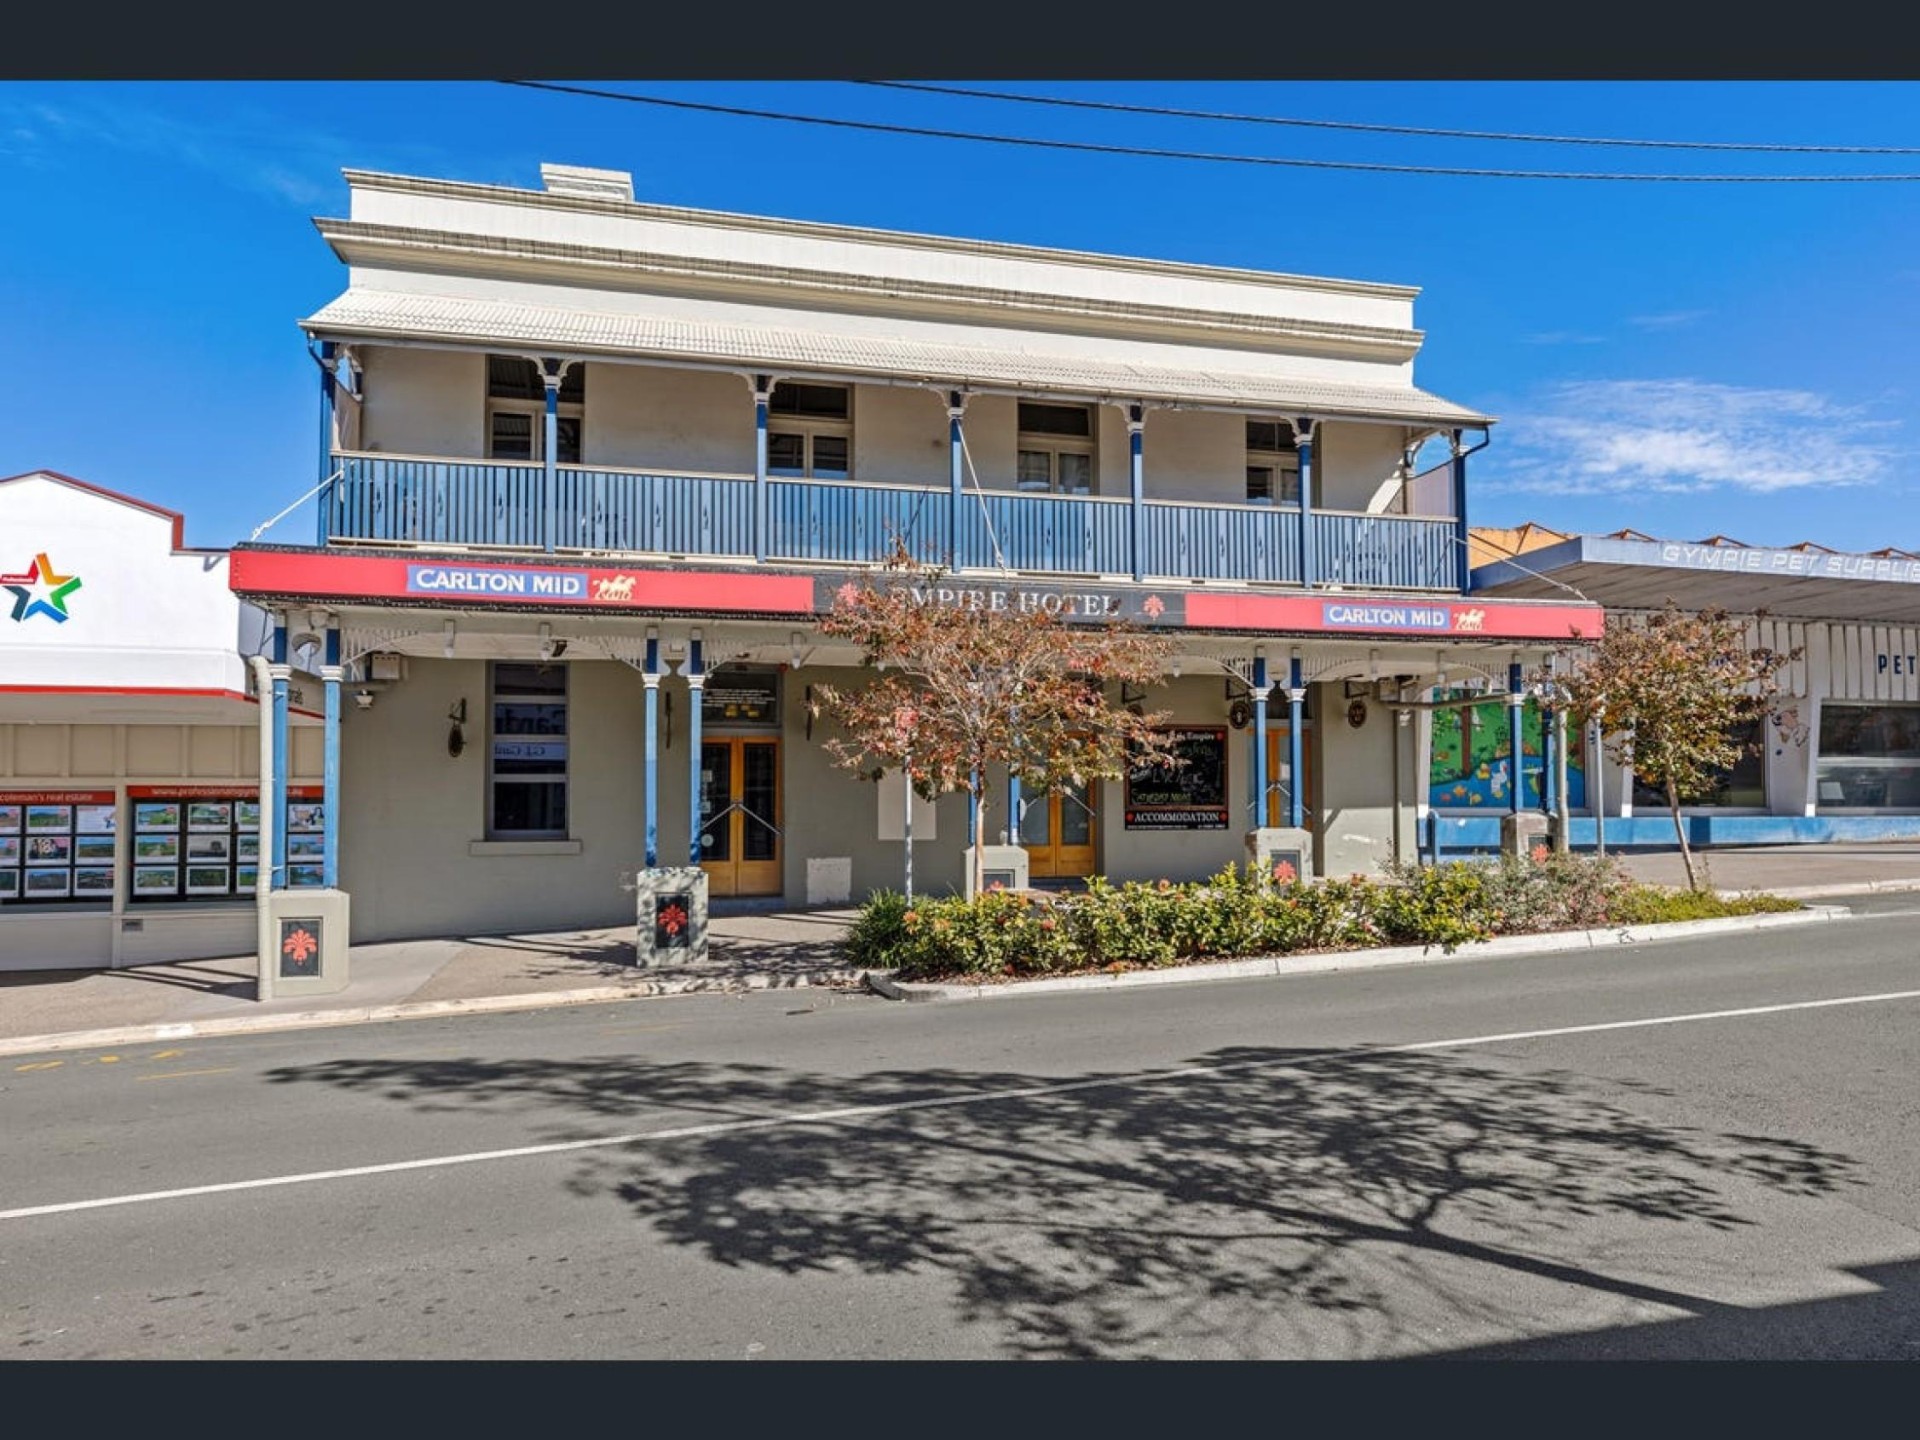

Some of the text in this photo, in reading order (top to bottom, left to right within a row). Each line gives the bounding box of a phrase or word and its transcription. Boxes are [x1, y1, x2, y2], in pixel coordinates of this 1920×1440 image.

[1663, 545, 1761, 568] GYMPIE
[1772, 552, 1820, 570] PET
[416, 568, 580, 595] CARLTON MID
[1018, 591, 1119, 616] HOTEL
[1329, 606, 1445, 626] CARLTON MID
[1877, 654, 1916, 675] PET
[1135, 812, 1219, 822] ACCOMMODATION
